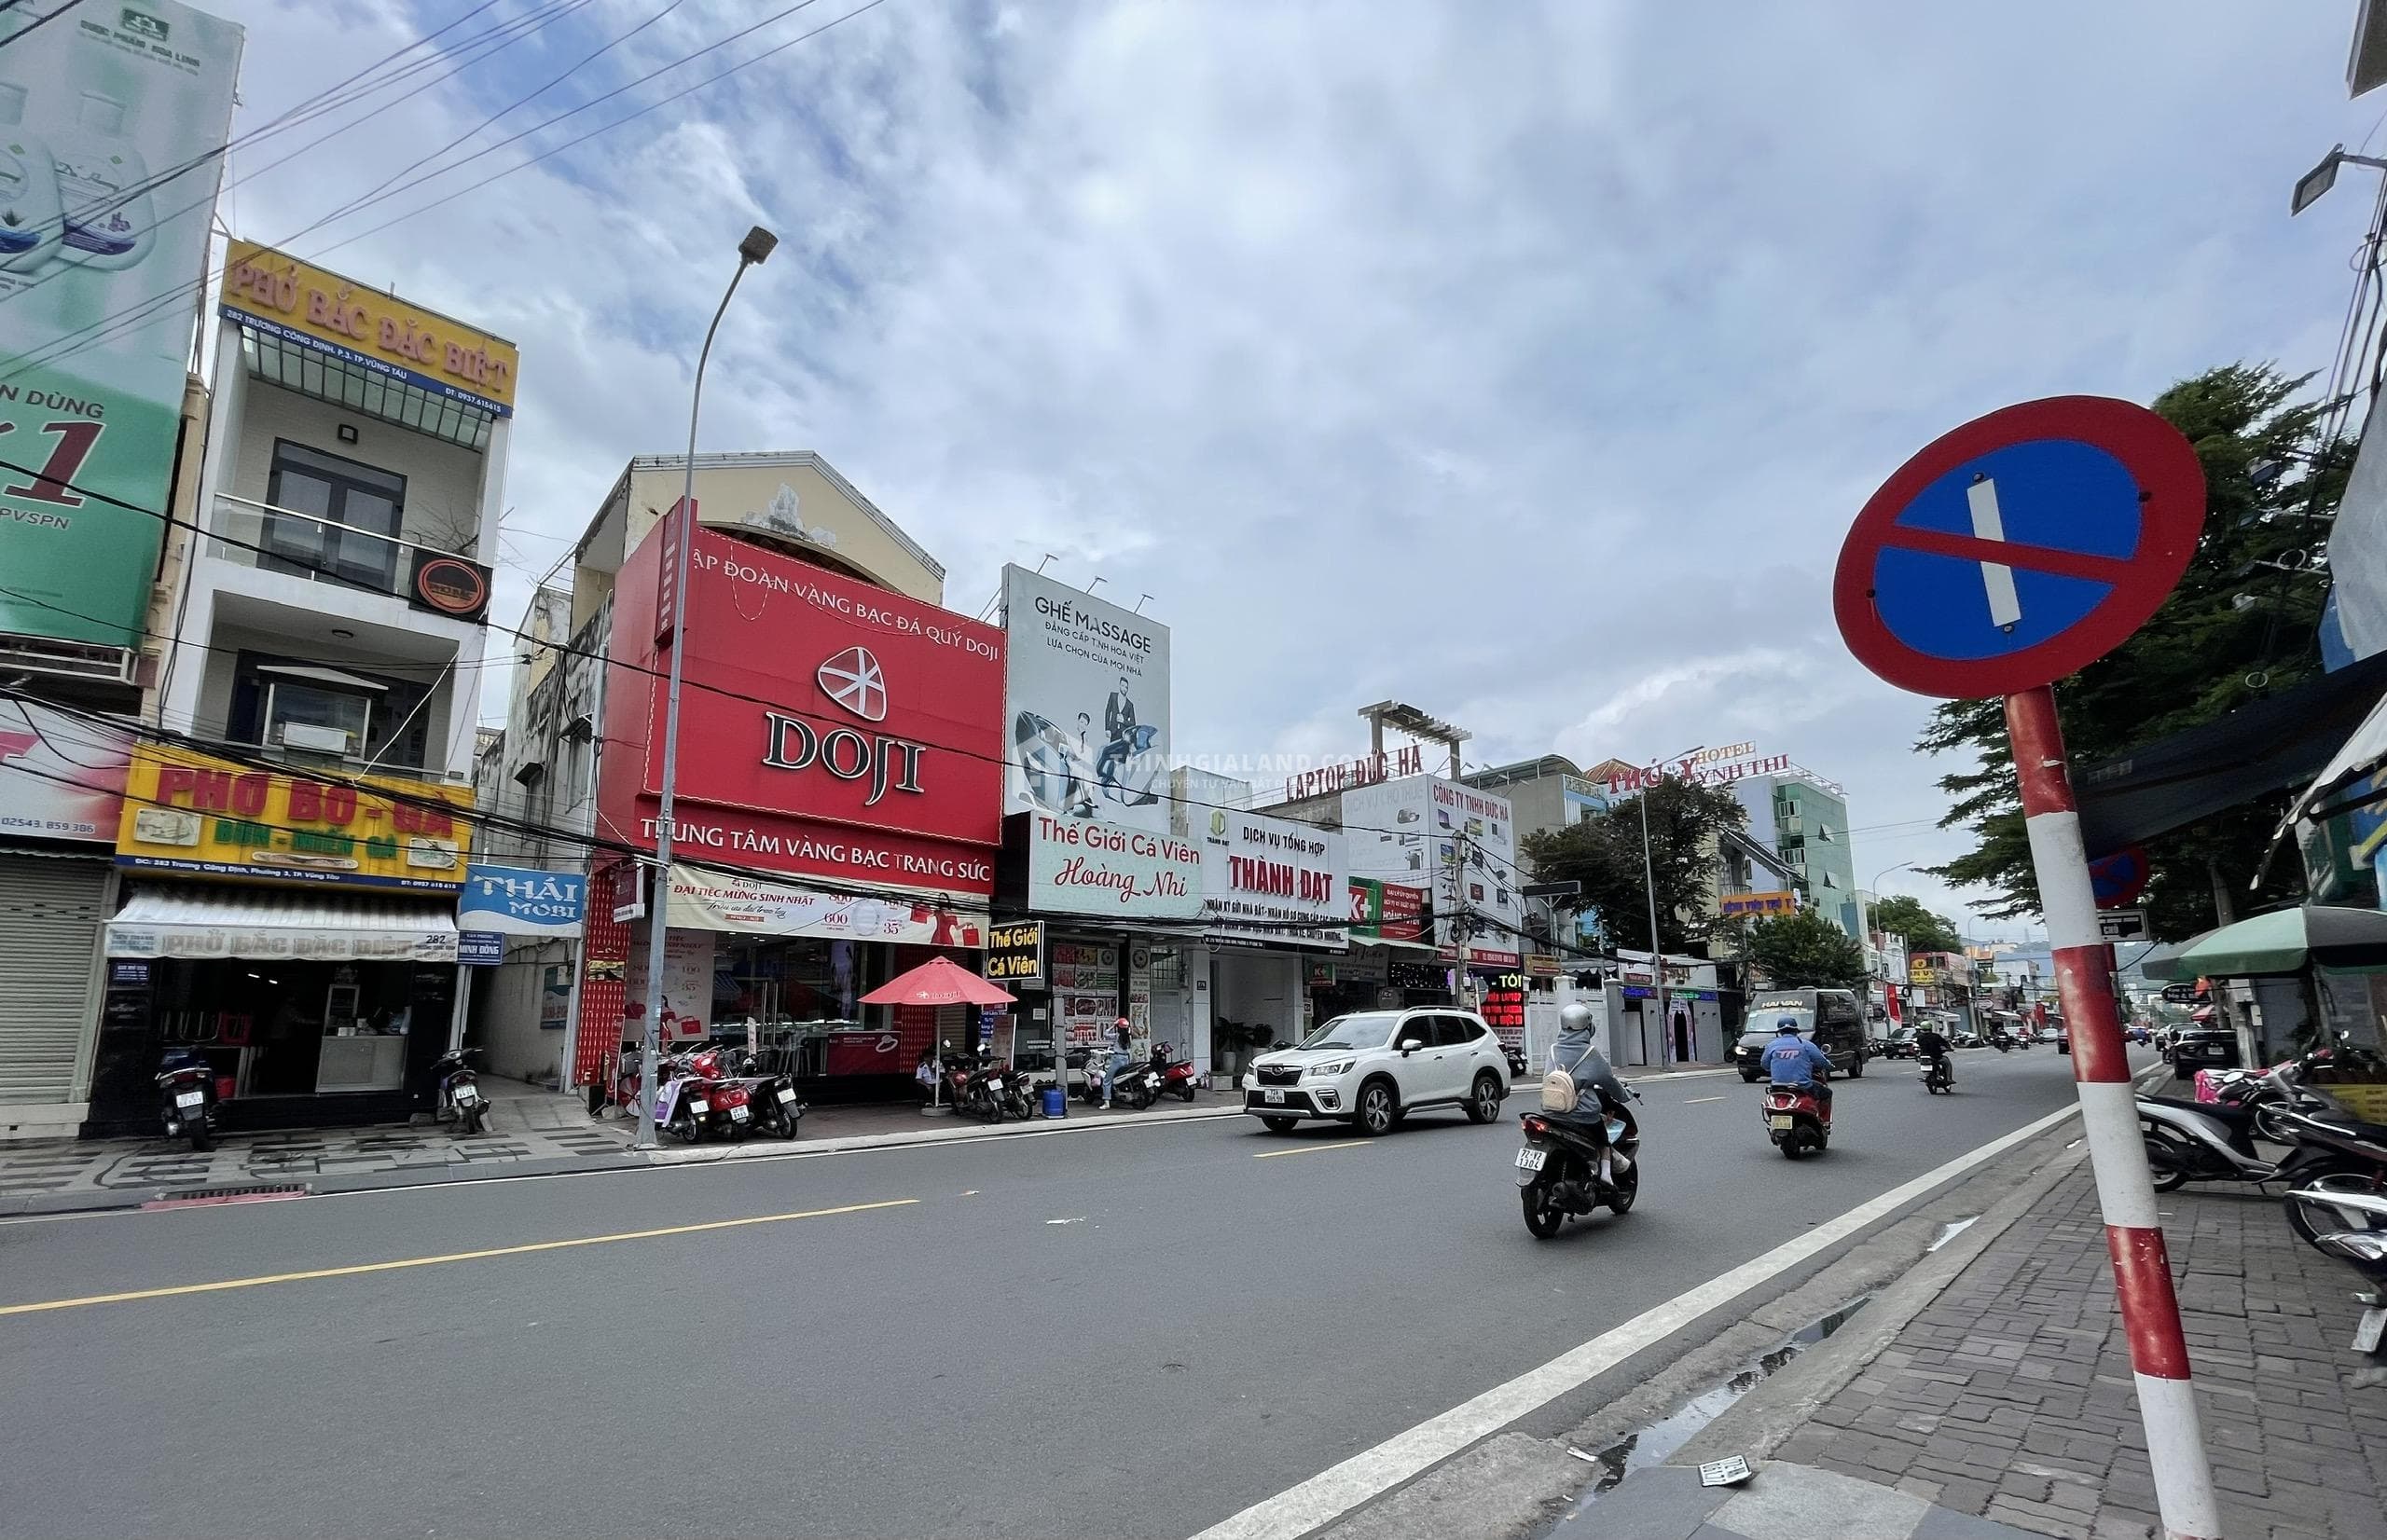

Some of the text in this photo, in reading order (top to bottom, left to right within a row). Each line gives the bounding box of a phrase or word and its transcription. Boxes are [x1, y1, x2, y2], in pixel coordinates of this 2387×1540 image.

[26, 389, 105, 419] DÙNG
[693, 548, 1000, 661] ẬP ĐOÀN VÀNG BẠC ĐÁ QUÝ DOJI
[1035, 597, 1152, 654] GHẾ MASSAGE
[1071, 628, 1090, 643] CẤP
[1111, 642, 1127, 658] HOA
[1065, 644, 1090, 660] CHỌN
[1126, 665, 1142, 678] NHÀ
[762, 711, 927, 806] DOJI
[1693, 741, 1756, 764] HOTEL
[1286, 737, 1425, 804] LAPTOP ĐỨC HÀ
[1607, 757, 1697, 794] THÚ Y
[1433, 782, 1509, 821] CÔNG TY TNHH ĐỨC HÀ
[47, 820, 69, 831] 859
[72, 823, 94, 833] 386
[1038, 817, 1200, 865] Thế Giới Cá Viên
[641, 818, 991, 882] TUNG TÂM VÀNG BẠC TRANG SỨC
[1243, 826, 1266, 845] DỊCH
[1268, 832, 1280, 850] VỤ
[1308, 840, 1325, 859] HỢP
[203, 862, 227, 873] Công
[1055, 856, 1188, 903] Hoàng Nhi
[1227, 854, 1333, 908] THÀNH ĐẠT
[473, 875, 578, 902] THÁI
[673, 885, 696, 896] ĐẠI
[723, 888, 757, 901] MỪNG
[758, 892, 784, 903] SINH
[785, 896, 816, 908] NHẬT
[508, 901, 576, 918] MOBI
[824, 913, 848, 925] 600
[426, 935, 446, 944] 282
[989, 927, 1038, 949] Thế Giới
[988, 956, 1037, 976] Cá Viên
